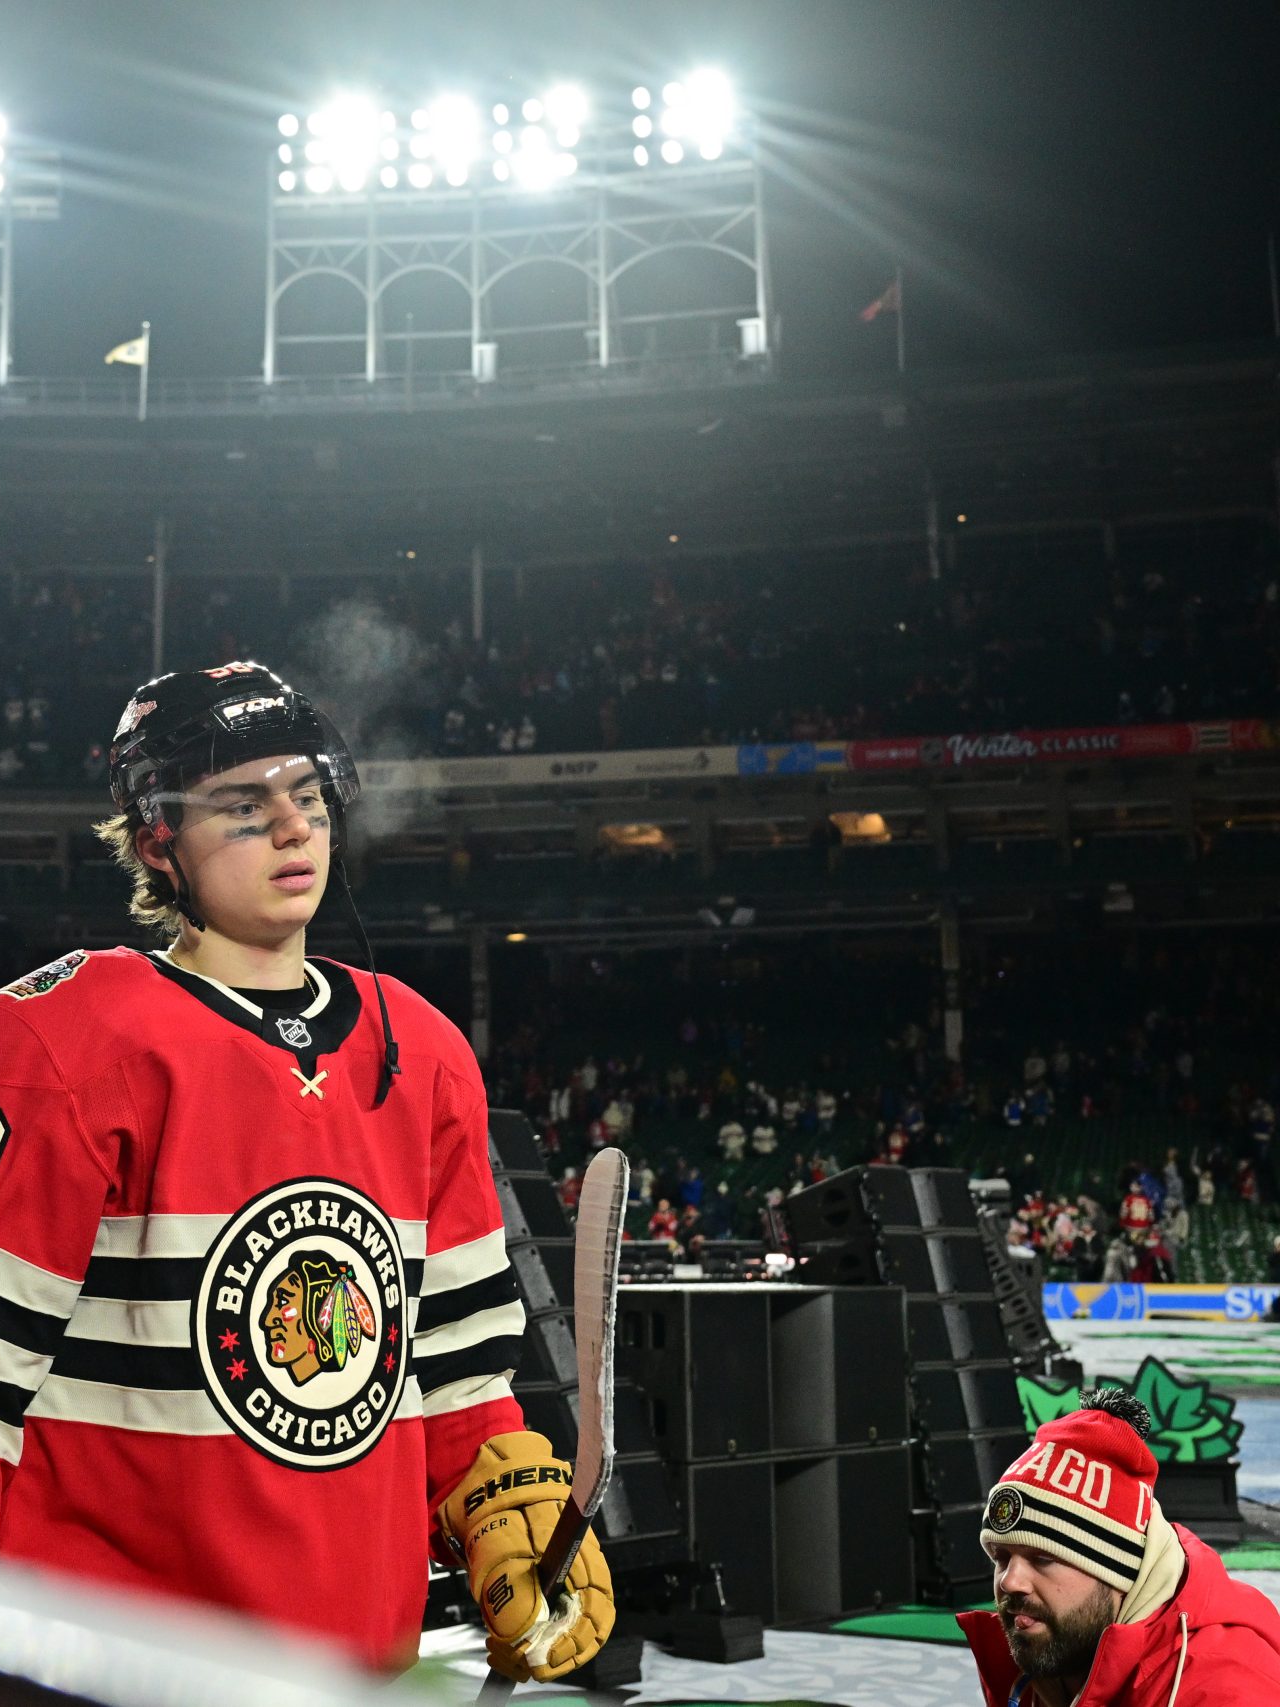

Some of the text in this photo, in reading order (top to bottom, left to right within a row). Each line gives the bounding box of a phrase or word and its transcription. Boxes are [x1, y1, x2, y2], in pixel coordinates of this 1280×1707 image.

[947, 733, 1037, 765] Winter
[1041, 734, 1120, 752] CLASSIC
[287, 1026, 302, 1041] NHL
[216, 1199, 400, 1315] BLACKHAWKS
[246, 1381, 387, 1447] CHICAGO
[556, 1540, 582, 1583] SHERWOOD
